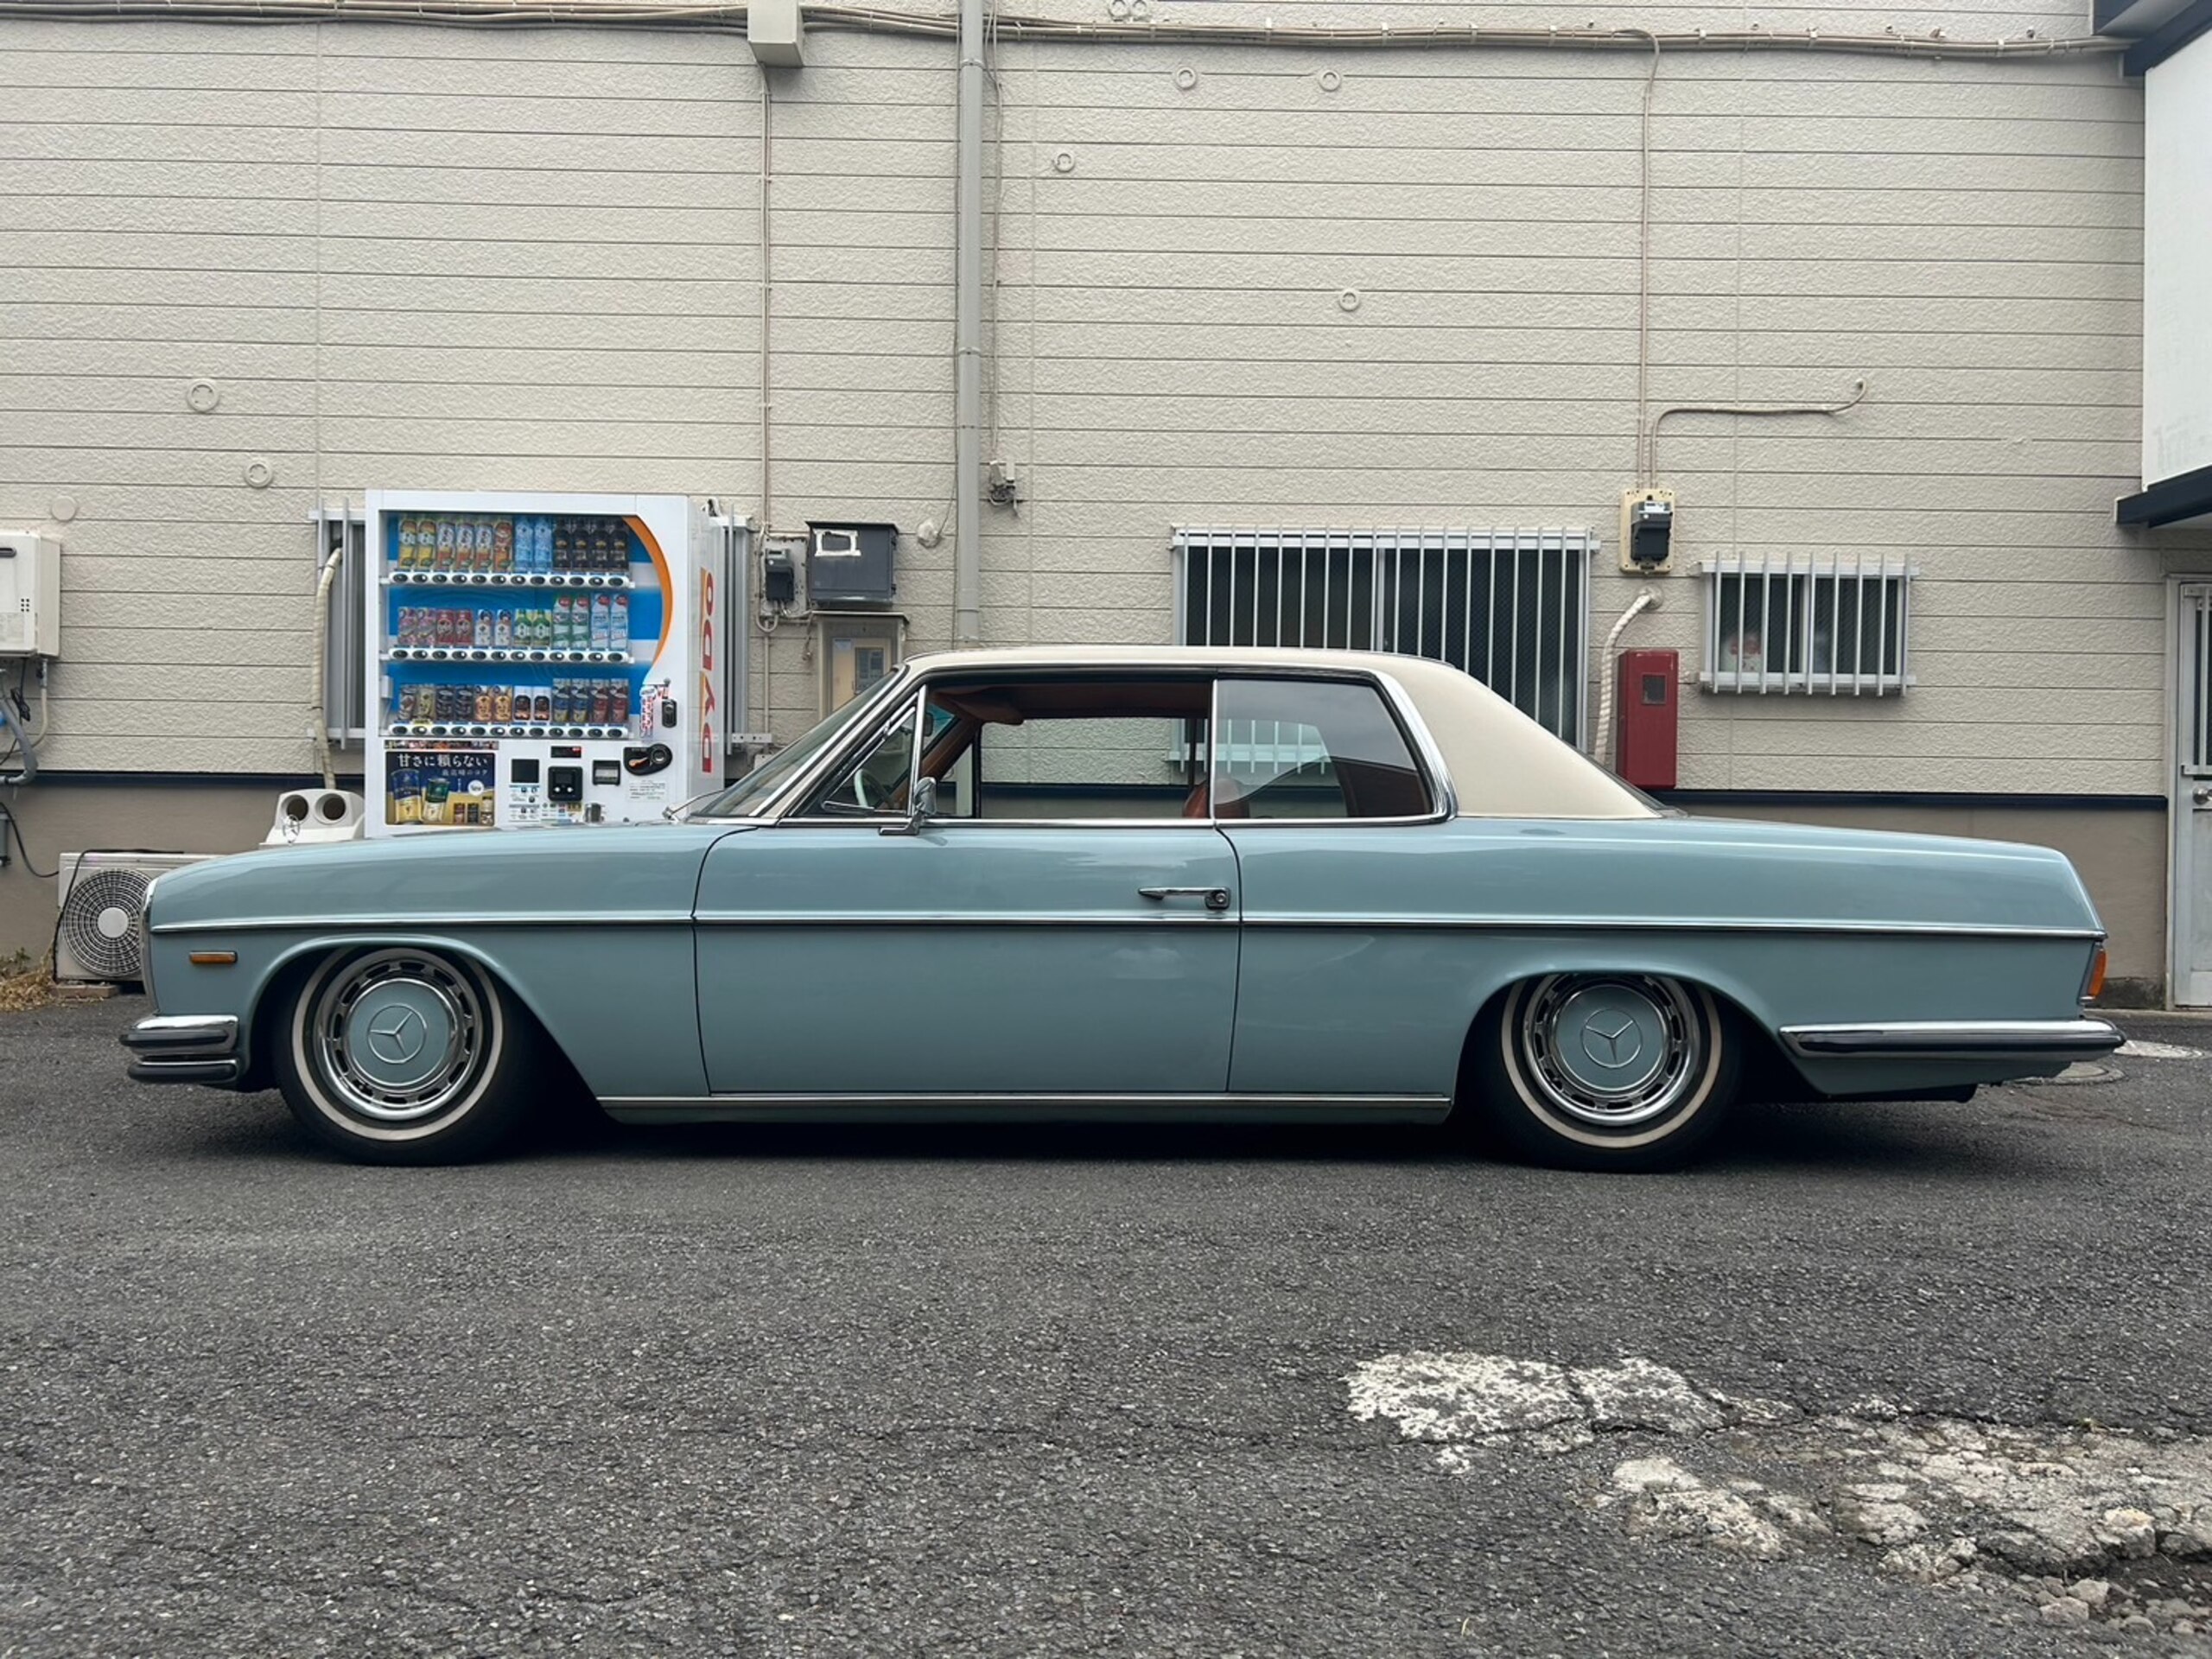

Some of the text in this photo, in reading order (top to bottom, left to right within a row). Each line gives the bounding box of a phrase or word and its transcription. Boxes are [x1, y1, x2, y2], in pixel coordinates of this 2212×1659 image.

[397, 753, 487, 768] 甘さに頼らない
